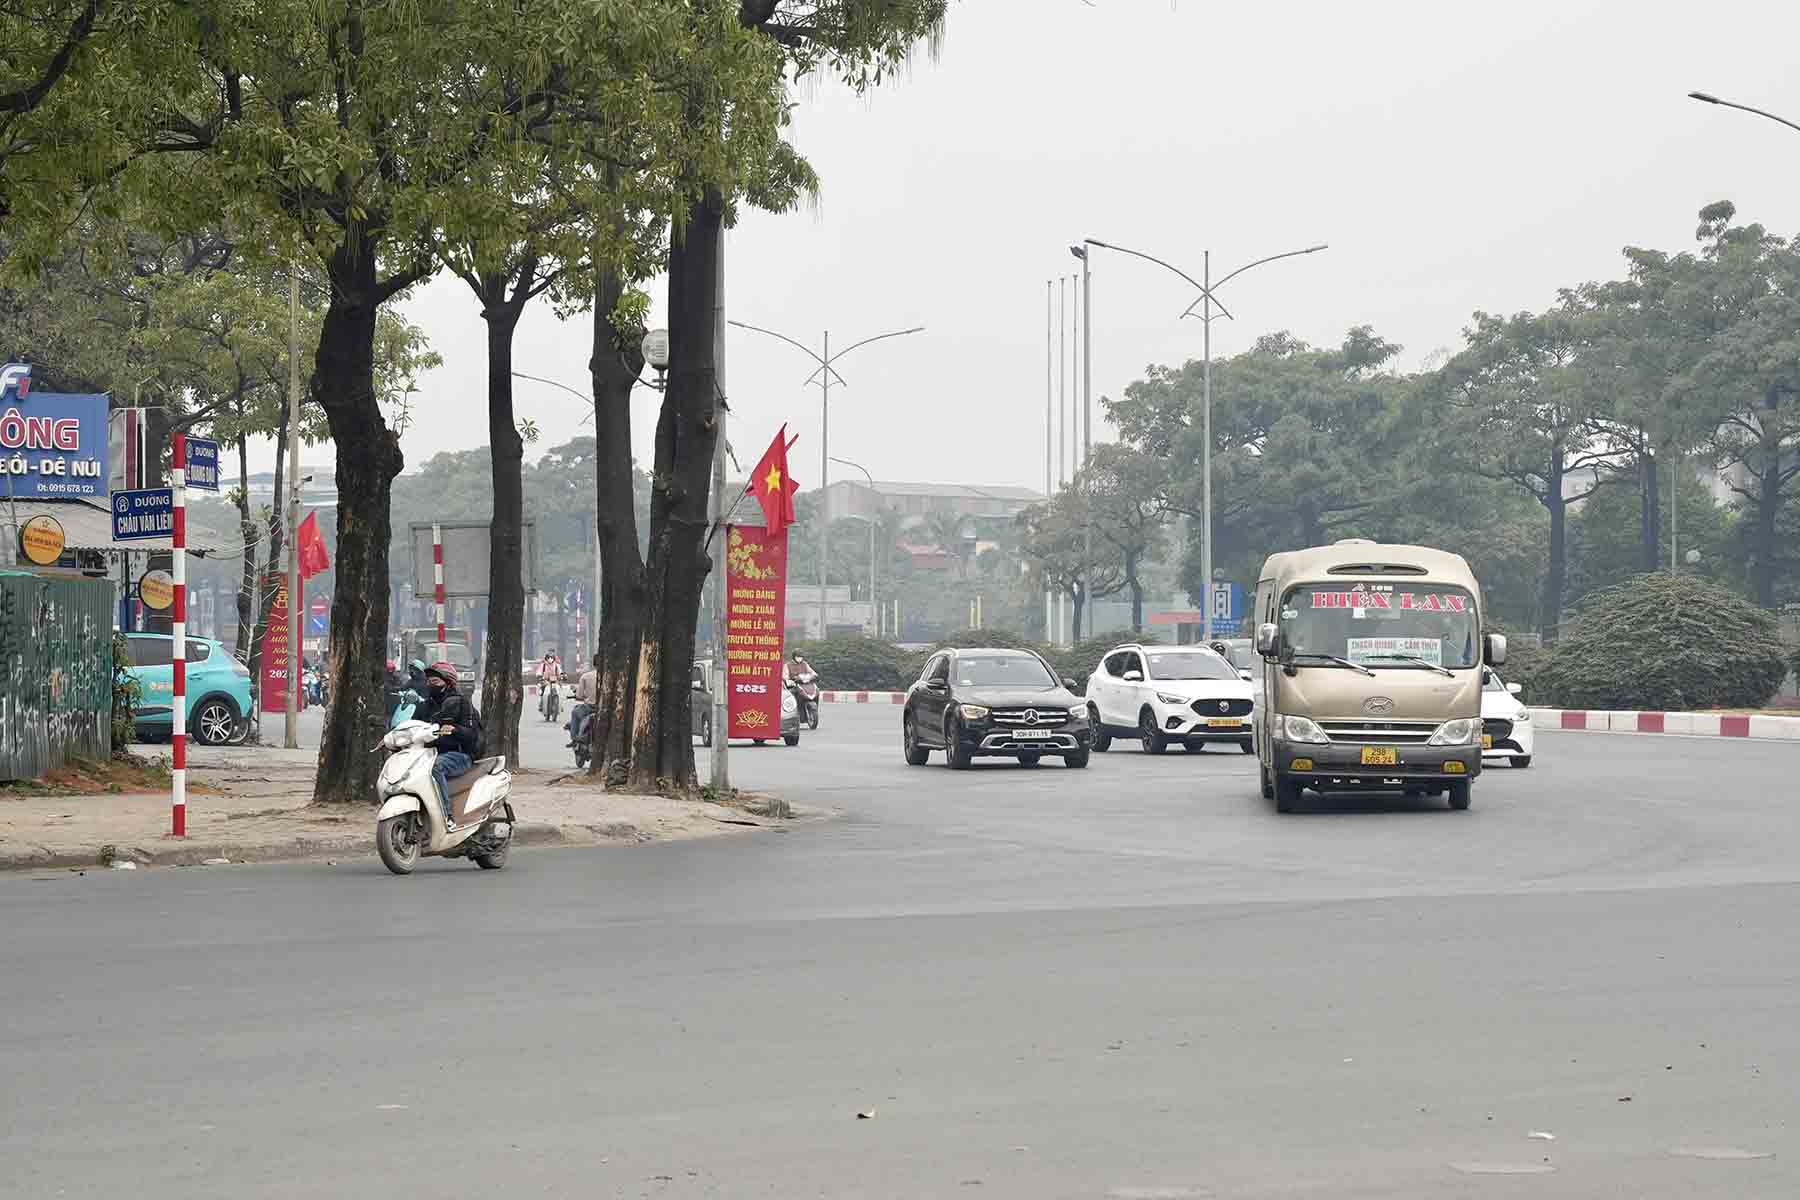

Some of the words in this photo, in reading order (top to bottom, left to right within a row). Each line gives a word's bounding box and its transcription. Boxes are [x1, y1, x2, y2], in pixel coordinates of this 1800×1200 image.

[0, 408, 79, 450] ÔNG
[40, 456, 66, 475] DÊ
[72, 457, 101, 477] NÚI
[49, 483, 66, 492] 0915
[67, 484, 80, 492] 678
[82, 485, 94, 493] 123
[118, 513, 138, 534] CHÂU
[140, 511, 155, 532] VĂN
[1399, 592, 1467, 612] LAN
[755, 603, 775, 615] XUÂN
[269, 669, 288, 679] 202
[730, 663, 752, 675] XUÂN
[736, 683, 768, 694] 2025
